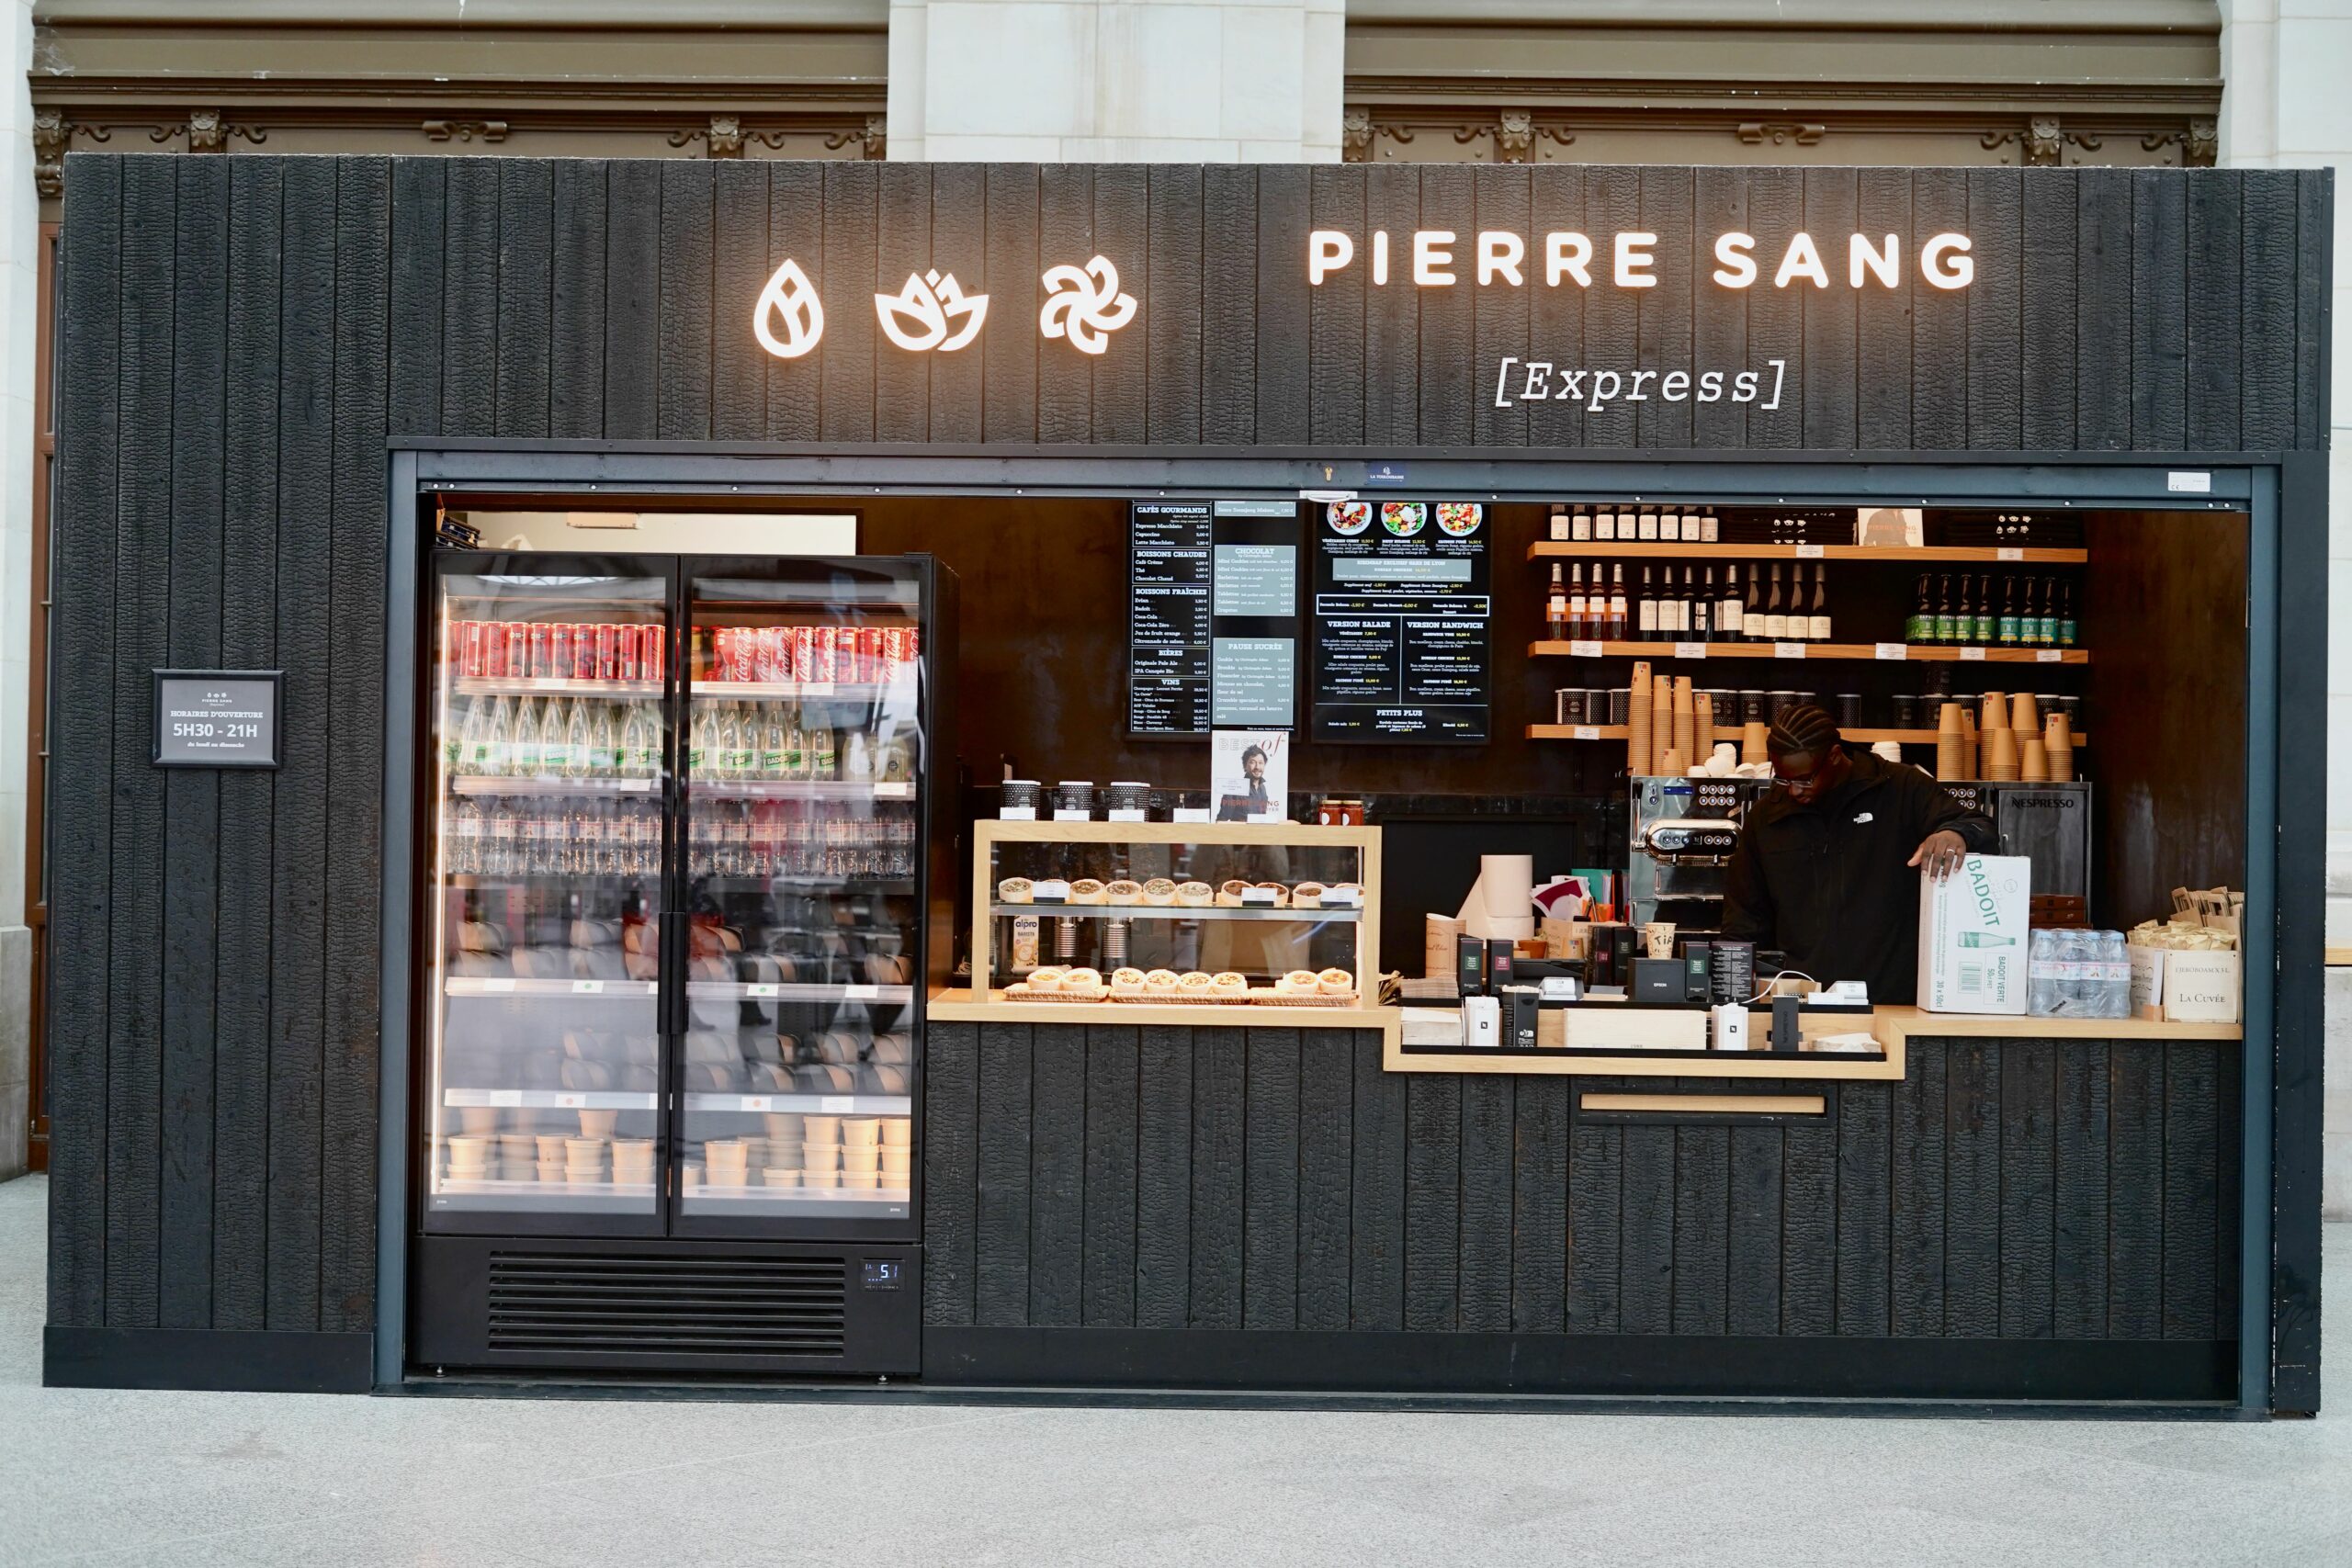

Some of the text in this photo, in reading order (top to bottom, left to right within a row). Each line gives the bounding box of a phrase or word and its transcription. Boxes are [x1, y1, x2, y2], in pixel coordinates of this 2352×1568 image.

[1308, 230, 1975, 290] PIERRE SANG
[1494, 356, 1785, 412] [Express]
[173, 723, 214, 736] 5H30
[227, 724, 258, 737] 21H
[2011, 796, 2074, 809] NESPRESSO
[1967, 859, 2000, 926] BADOIT
[1015, 919, 1038, 929] alpro
[1936, 980, 1945, 988] 30
[1997, 956, 2006, 1003] BADOIT VERTE
